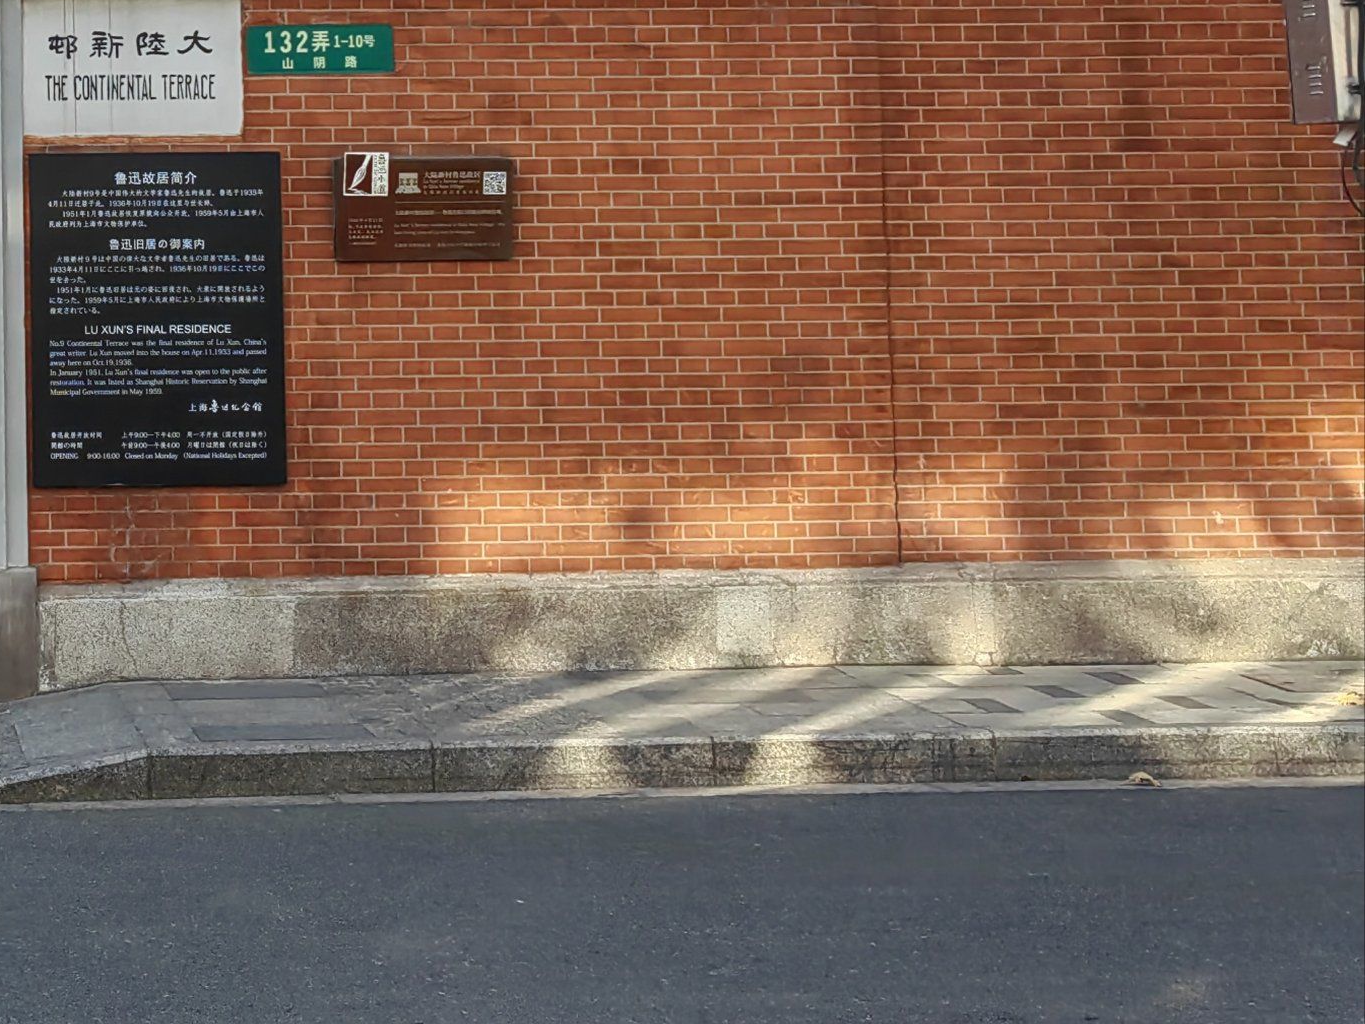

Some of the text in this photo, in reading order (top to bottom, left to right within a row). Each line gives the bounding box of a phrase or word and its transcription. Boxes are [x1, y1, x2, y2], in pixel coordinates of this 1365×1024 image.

[282, 56, 358, 70] 山阴路
[45, 74, 216, 101] THE CONTINENTAL TERRACE
[114, 172, 198, 186] 鲁迅故居简介
[84, 324, 232, 334] LU XUN'S FINAL RESIDENCE
[50, 350, 66, 358] great
[246, 348, 266, 356] passed
[232, 368, 250, 376] public
[134, 378, 164, 386] Shanghai
[228, 378, 238, 386] by
[238, 378, 268, 386] Shanghai
[154, 452, 178, 460] Monday
